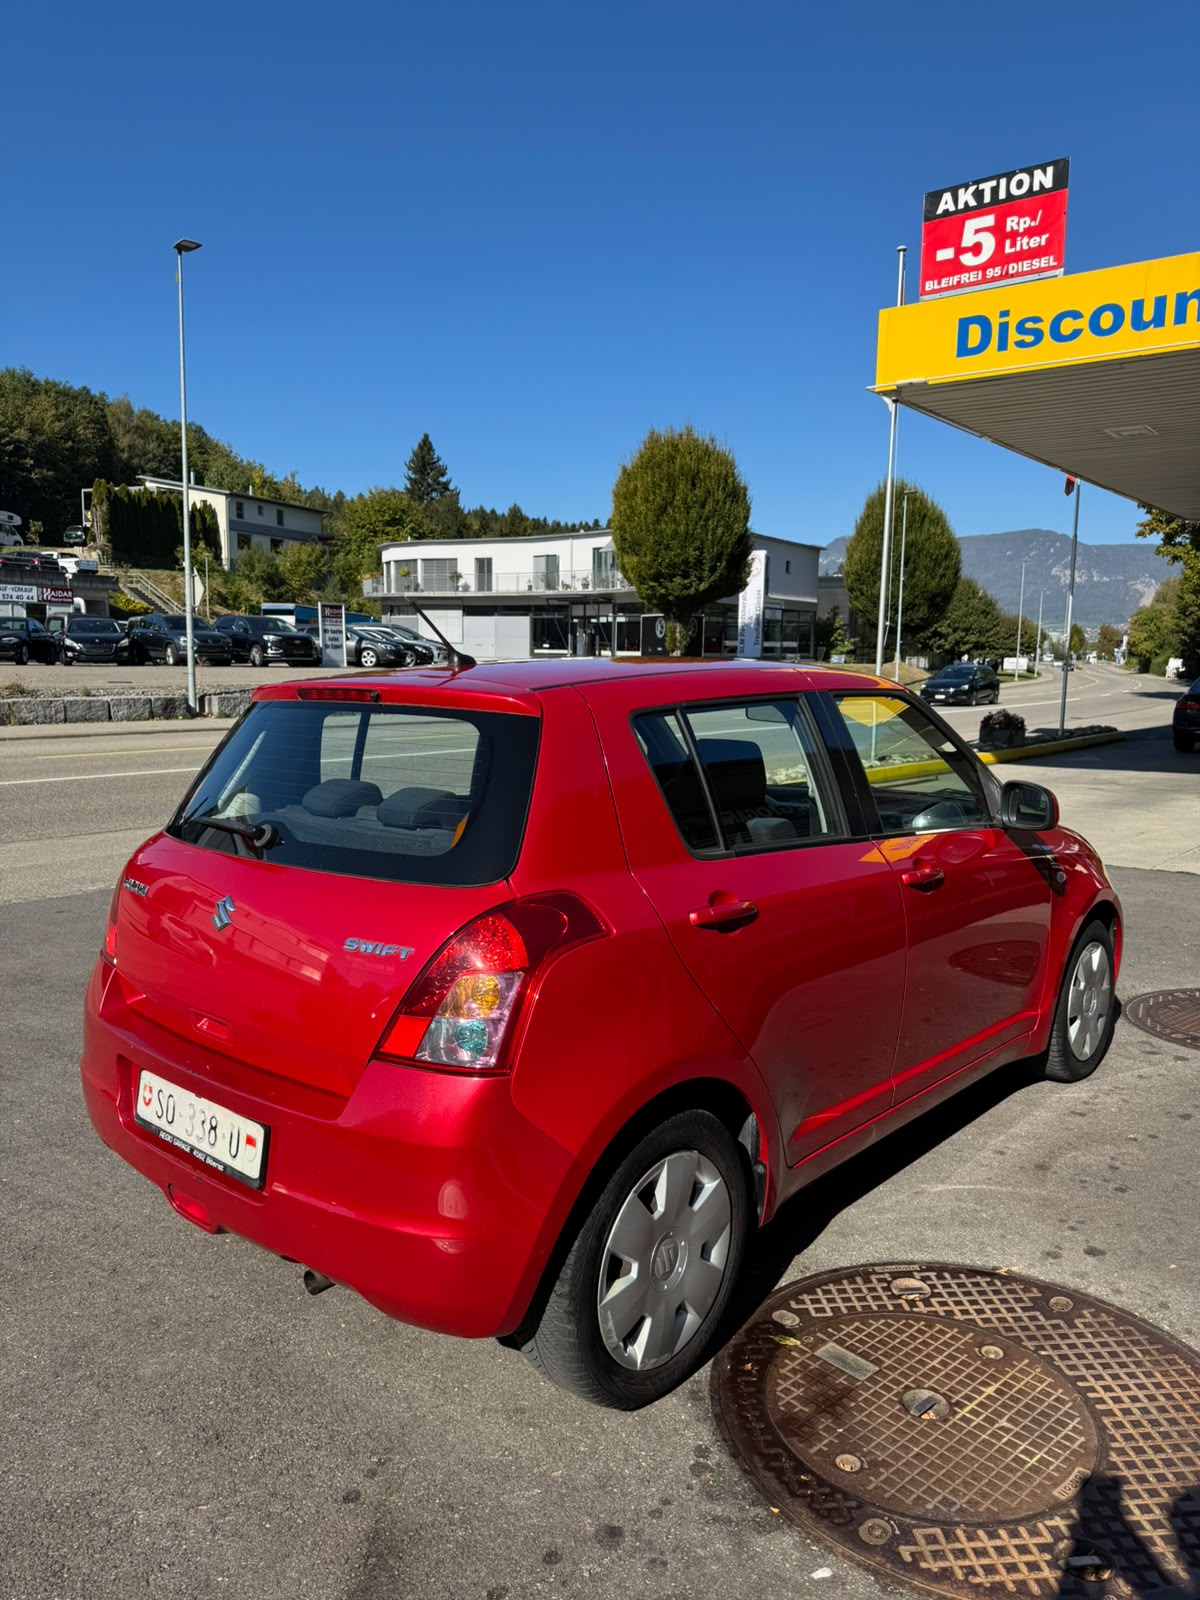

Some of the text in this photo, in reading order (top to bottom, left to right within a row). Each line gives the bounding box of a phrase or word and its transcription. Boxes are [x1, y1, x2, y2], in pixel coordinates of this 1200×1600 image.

[936, 165, 1054, 215] AKTION
[1005, 209, 1043, 233] Rp./
[935, 213, 997, 267] -5
[1004, 233, 1050, 254] Liter
[925, 271, 982, 291] BLEIFREI
[343, 937, 415, 961] SWIFT
[155, 1089, 176, 1125] SO
